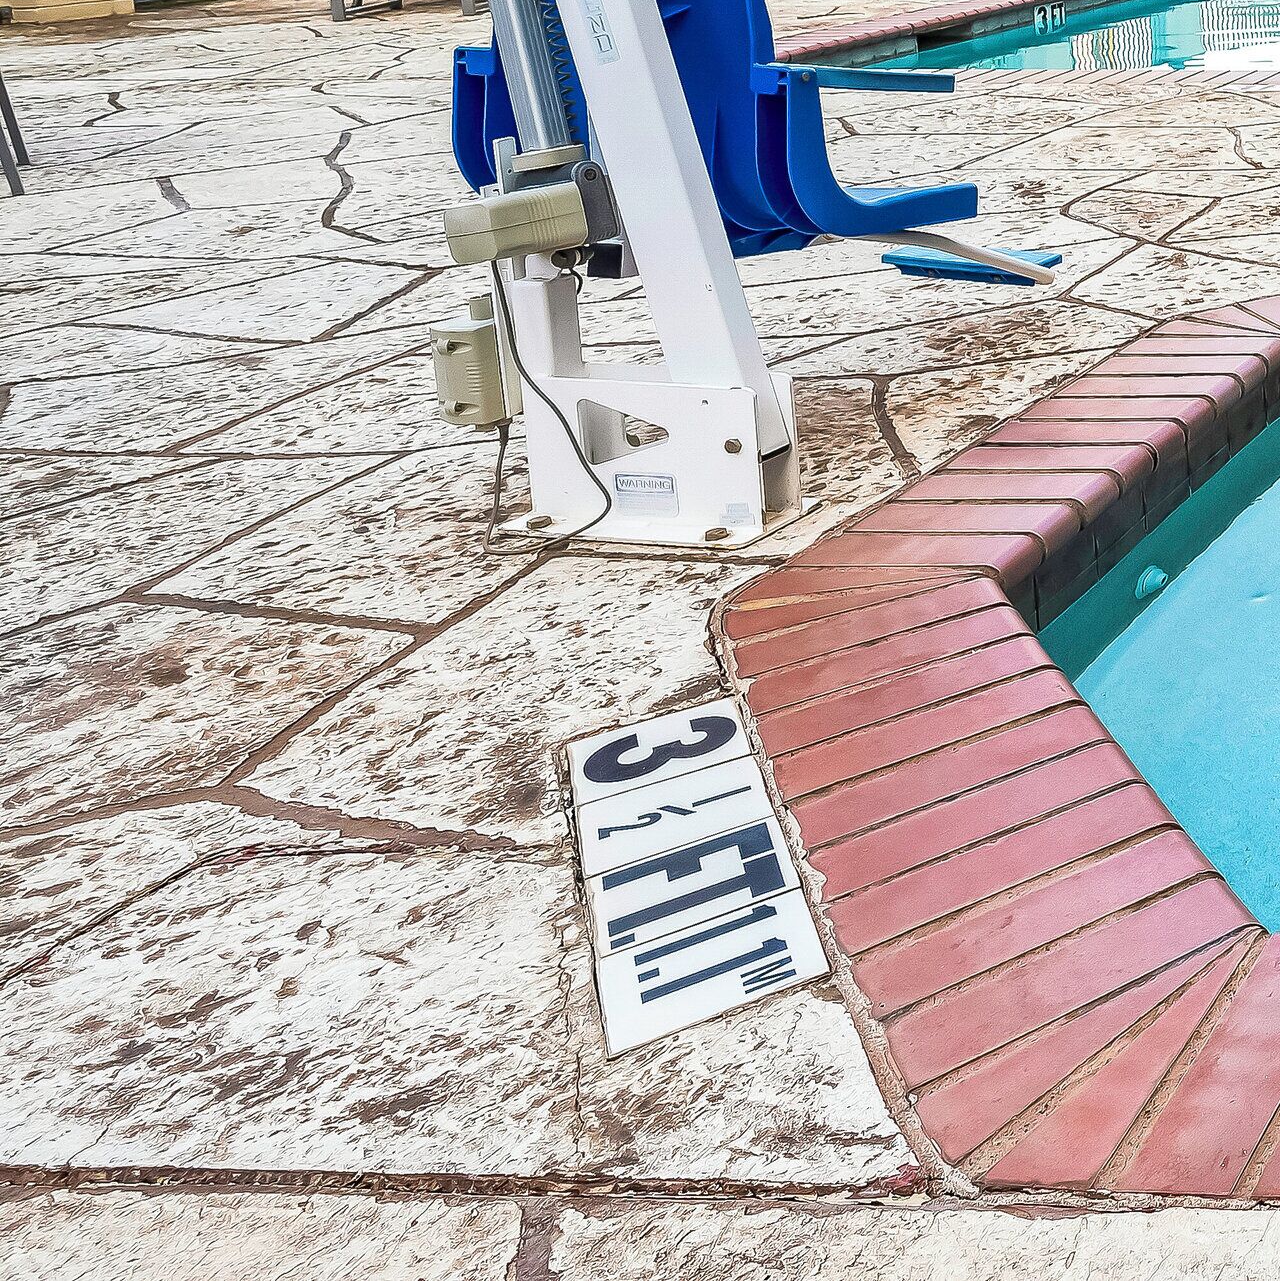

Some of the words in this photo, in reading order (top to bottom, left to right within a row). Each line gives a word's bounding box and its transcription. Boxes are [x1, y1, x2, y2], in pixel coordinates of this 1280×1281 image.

[1037, 6, 1048, 35] 3
[1051, 2, 1065, 32] FT
[618, 478, 671, 490] WARNING
[583, 715, 737, 783] 3
